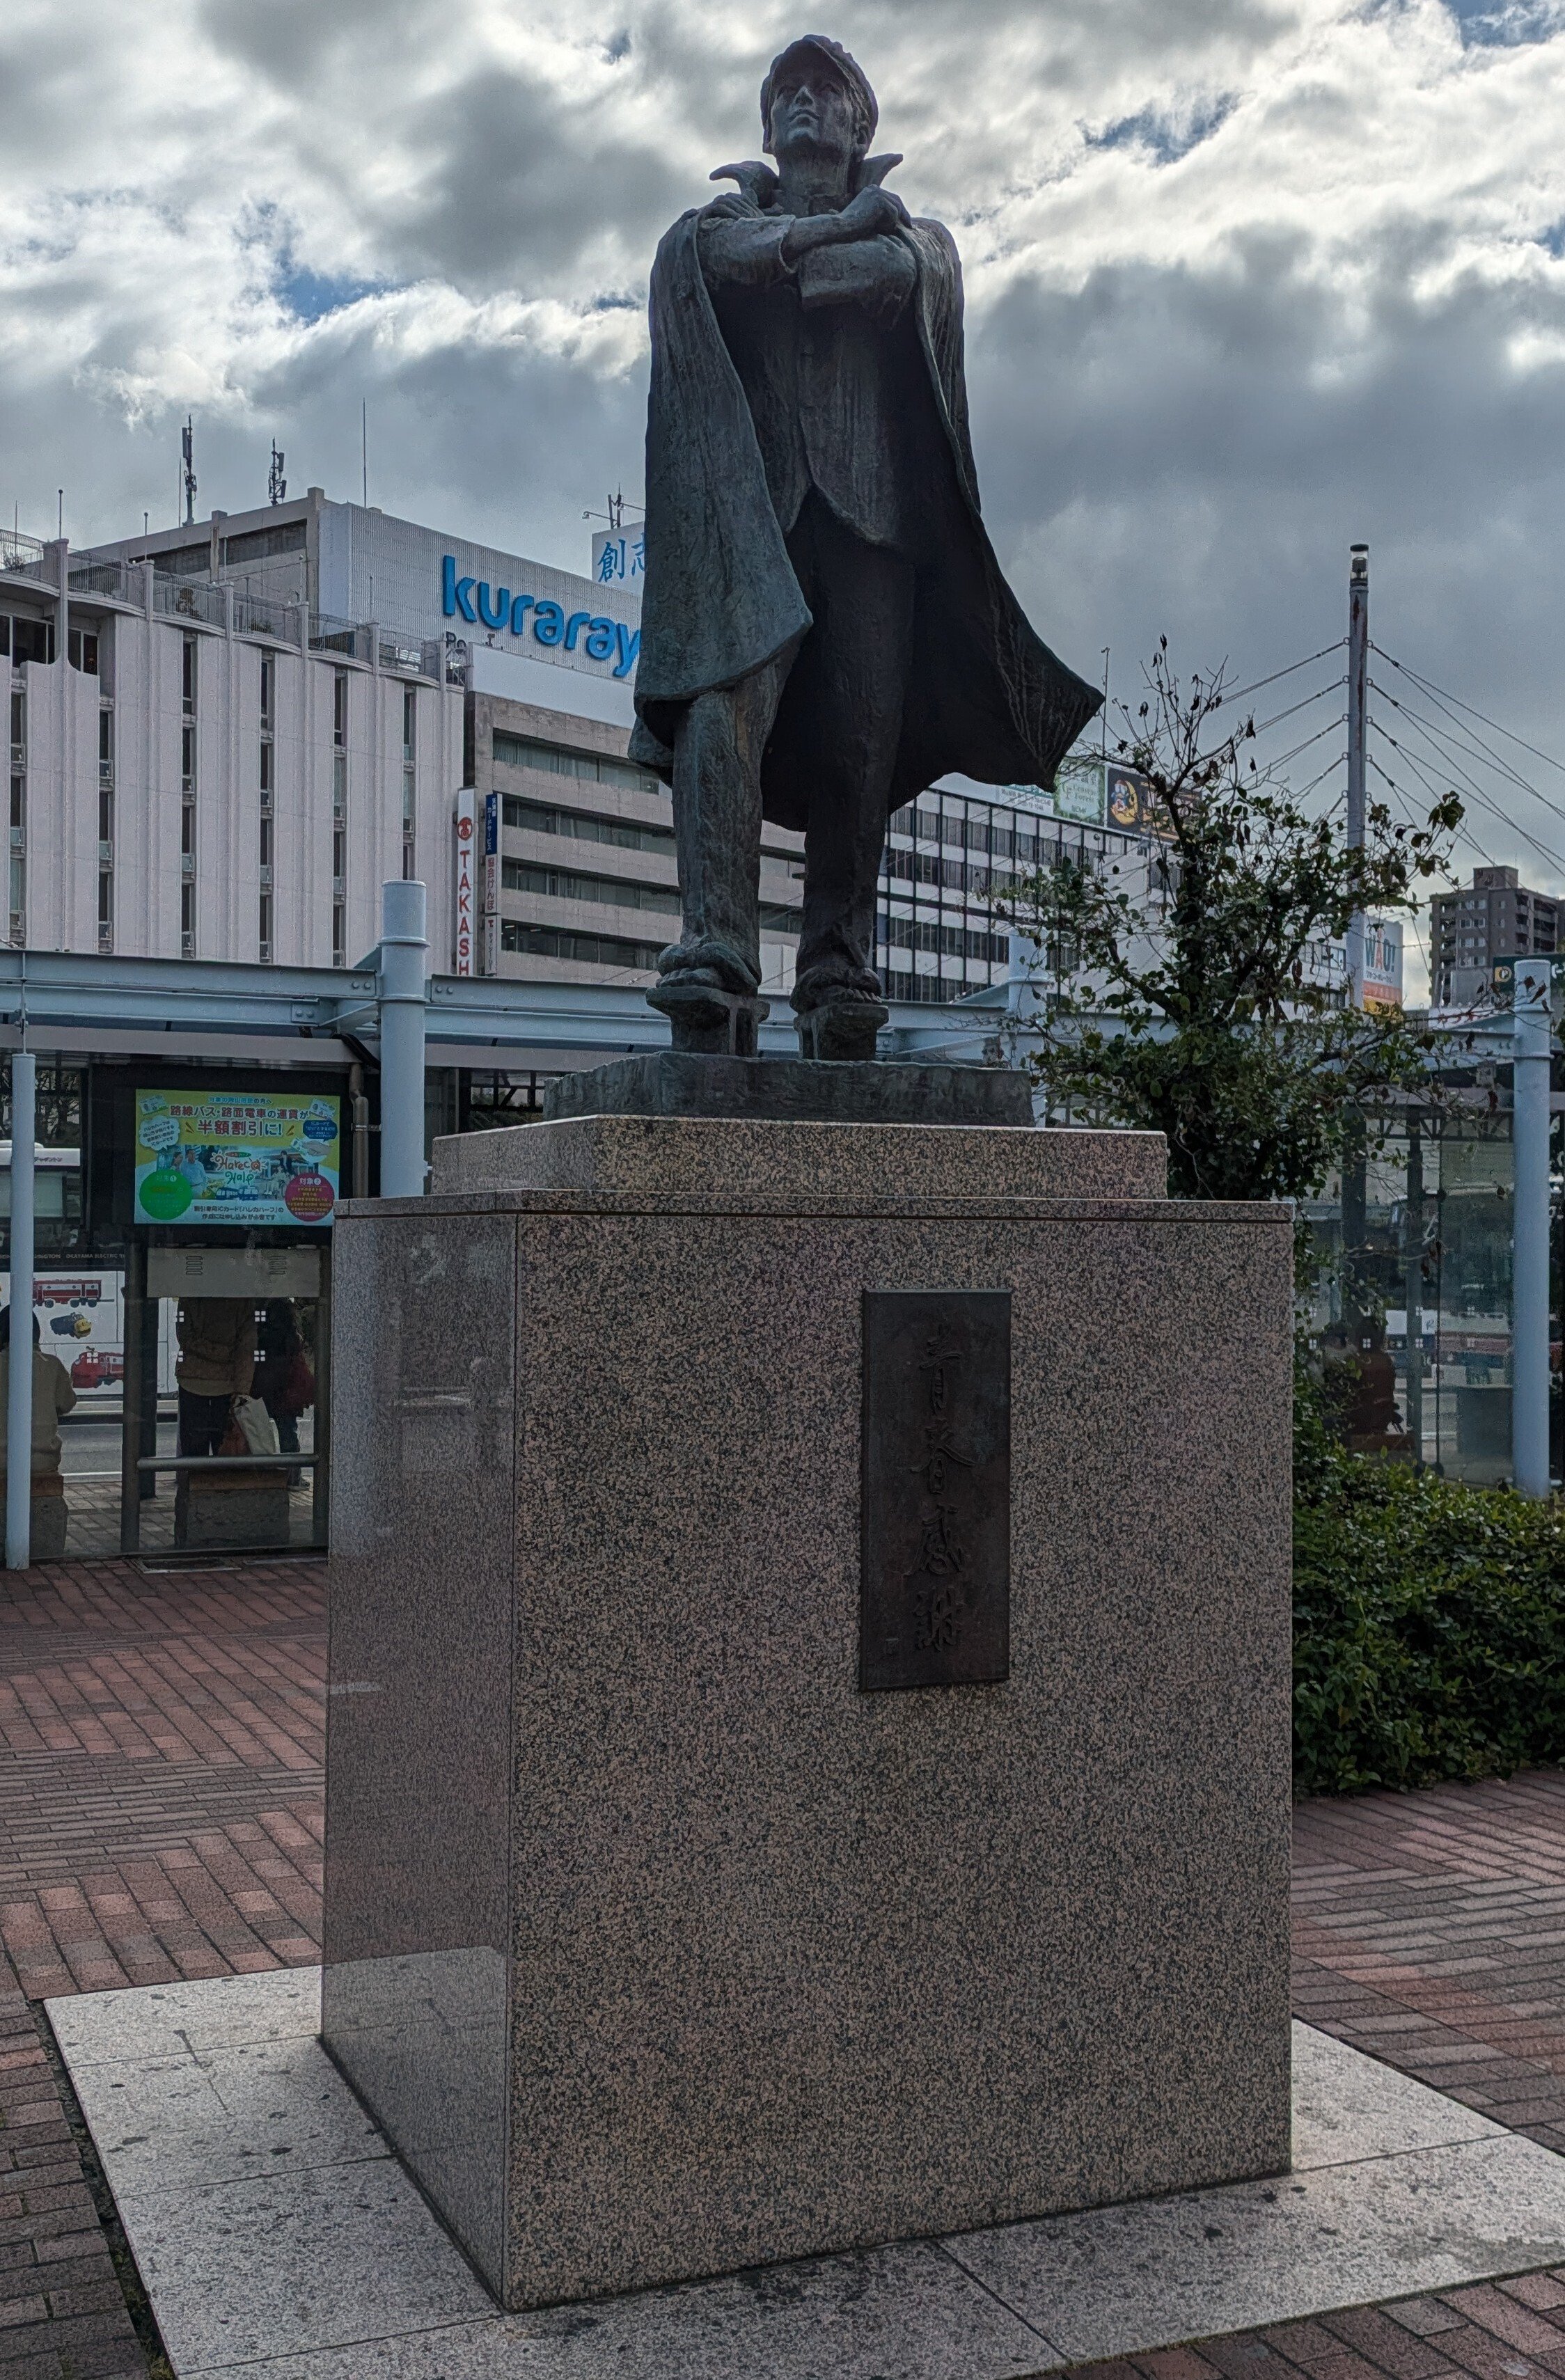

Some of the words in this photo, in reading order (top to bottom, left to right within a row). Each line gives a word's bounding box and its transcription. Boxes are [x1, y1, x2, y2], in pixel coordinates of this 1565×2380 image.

[442, 554, 640, 678] kuraray
[904, 1324, 976, 1652] 青春感謝
